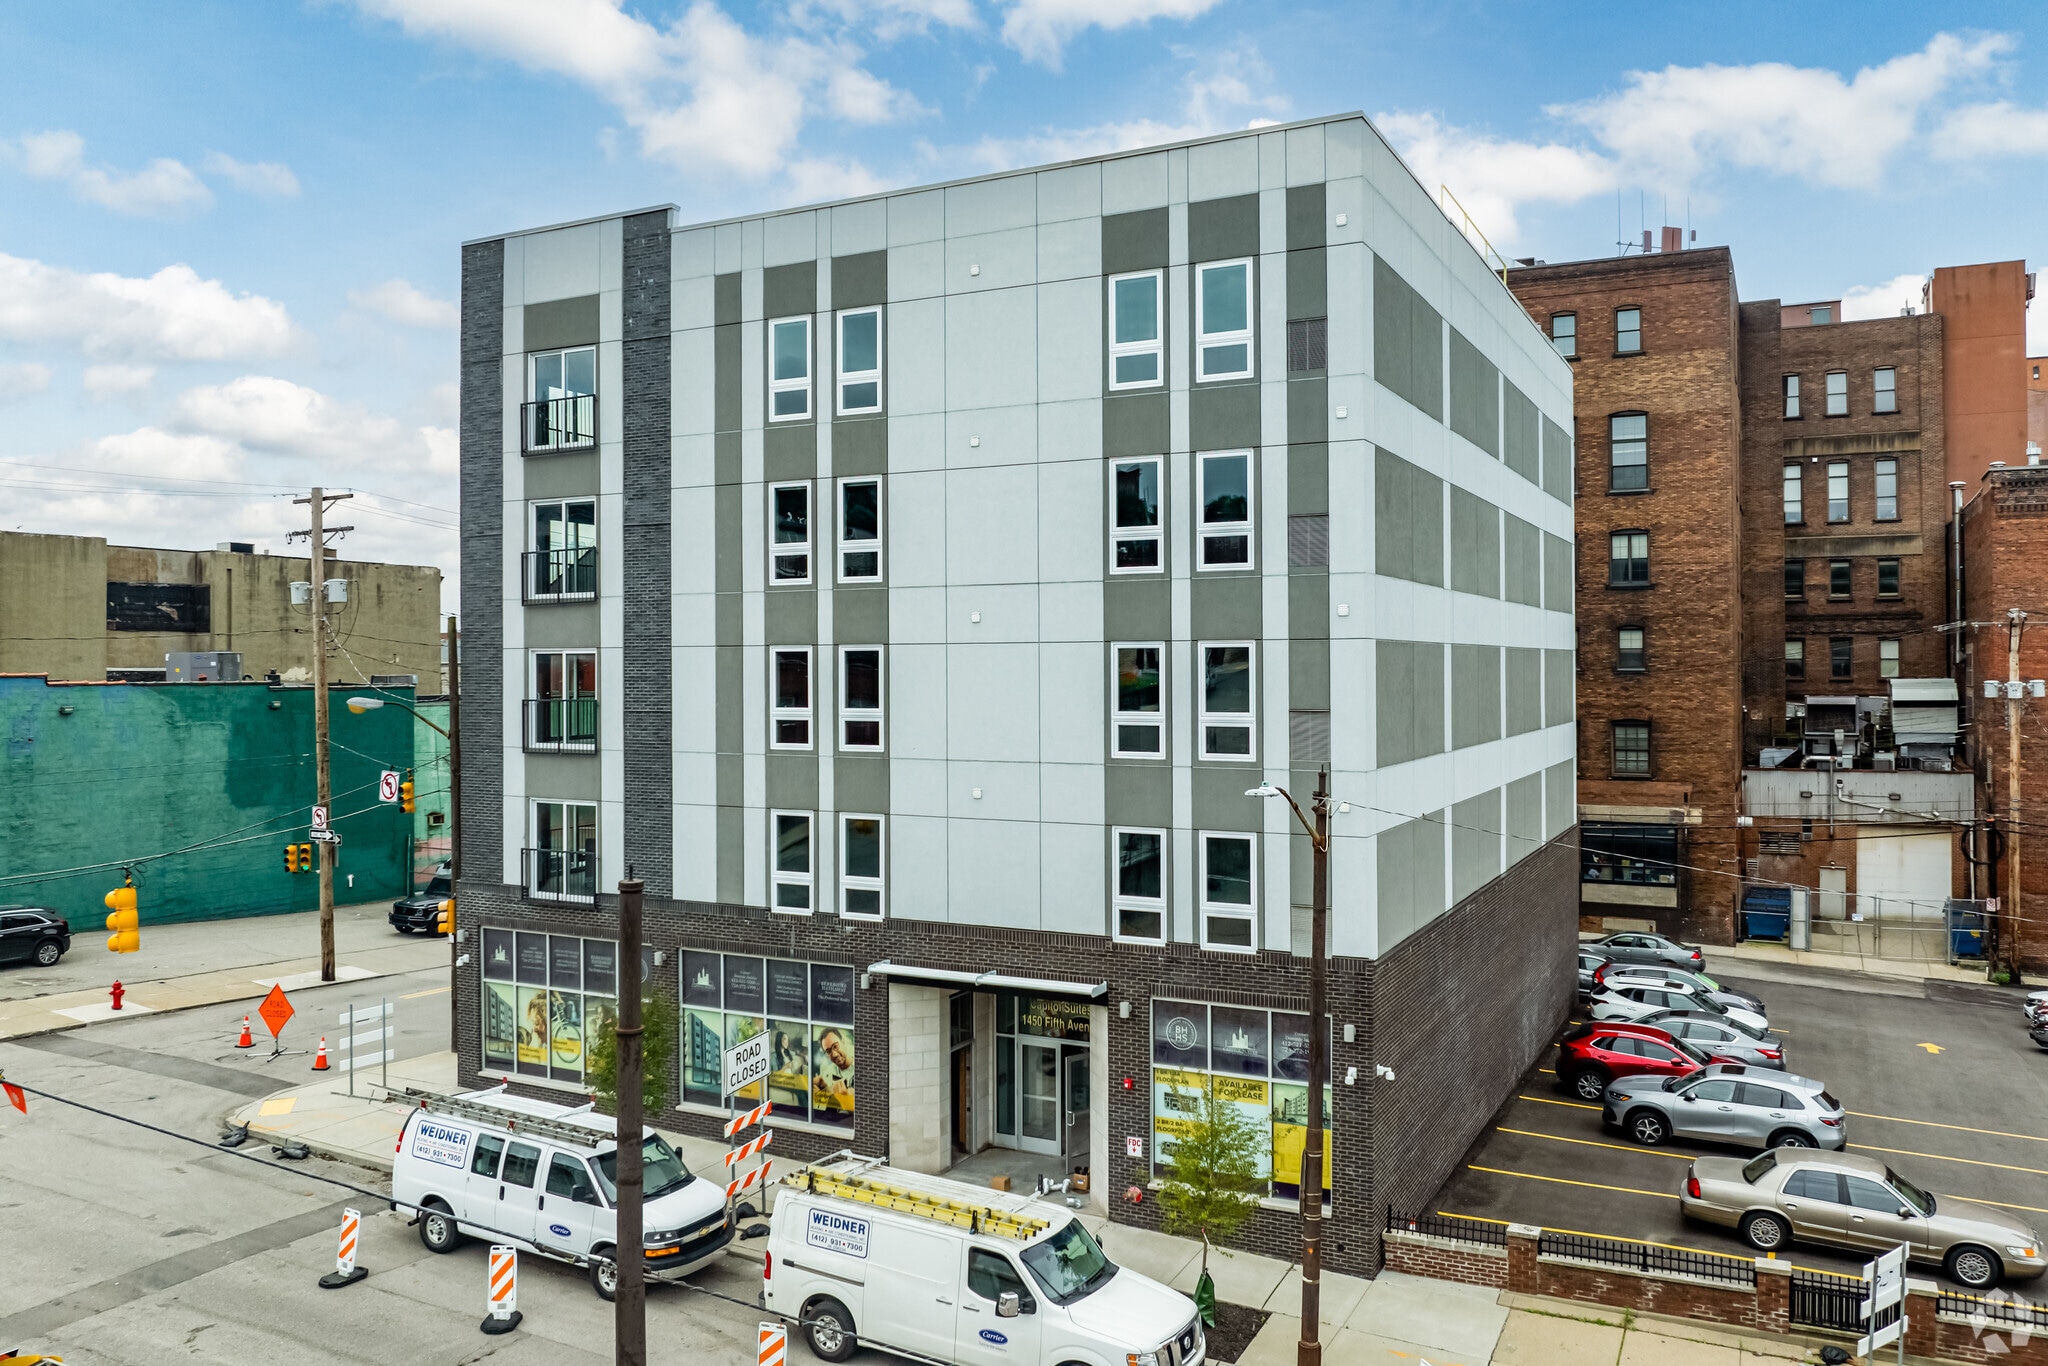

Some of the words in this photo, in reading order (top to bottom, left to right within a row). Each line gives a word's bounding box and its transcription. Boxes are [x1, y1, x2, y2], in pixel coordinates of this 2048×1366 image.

[1023, 1015, 1042, 1027] 1450
[1045, 1016, 1065, 1029] Fifth
[1175, 1025, 1188, 1034] BH
[1175, 1033, 1188, 1043] HS
[736, 1043, 761, 1066] ROAD
[730, 1058, 767, 1087] CLOSED
[1218, 1080, 1264, 1092] AVAILABLE
[1238, 1090, 1264, 1101] LEASE
[421, 1124, 467, 1146] WEIDNER
[1128, 1138, 1141, 1147] FDC
[416, 1145, 431, 1155] (412)
[432, 1149, 443, 1158] 931
[447, 1152, 462, 1163] 7300
[552, 1225, 569, 1235] Carrier
[812, 1212, 866, 1236] WEIDNER
[811, 1233, 828, 1244] (412)
[830, 1238, 842, 1247] 931
[846, 1242, 863, 1252] 7300
[982, 1331, 1005, 1342] Carrier
